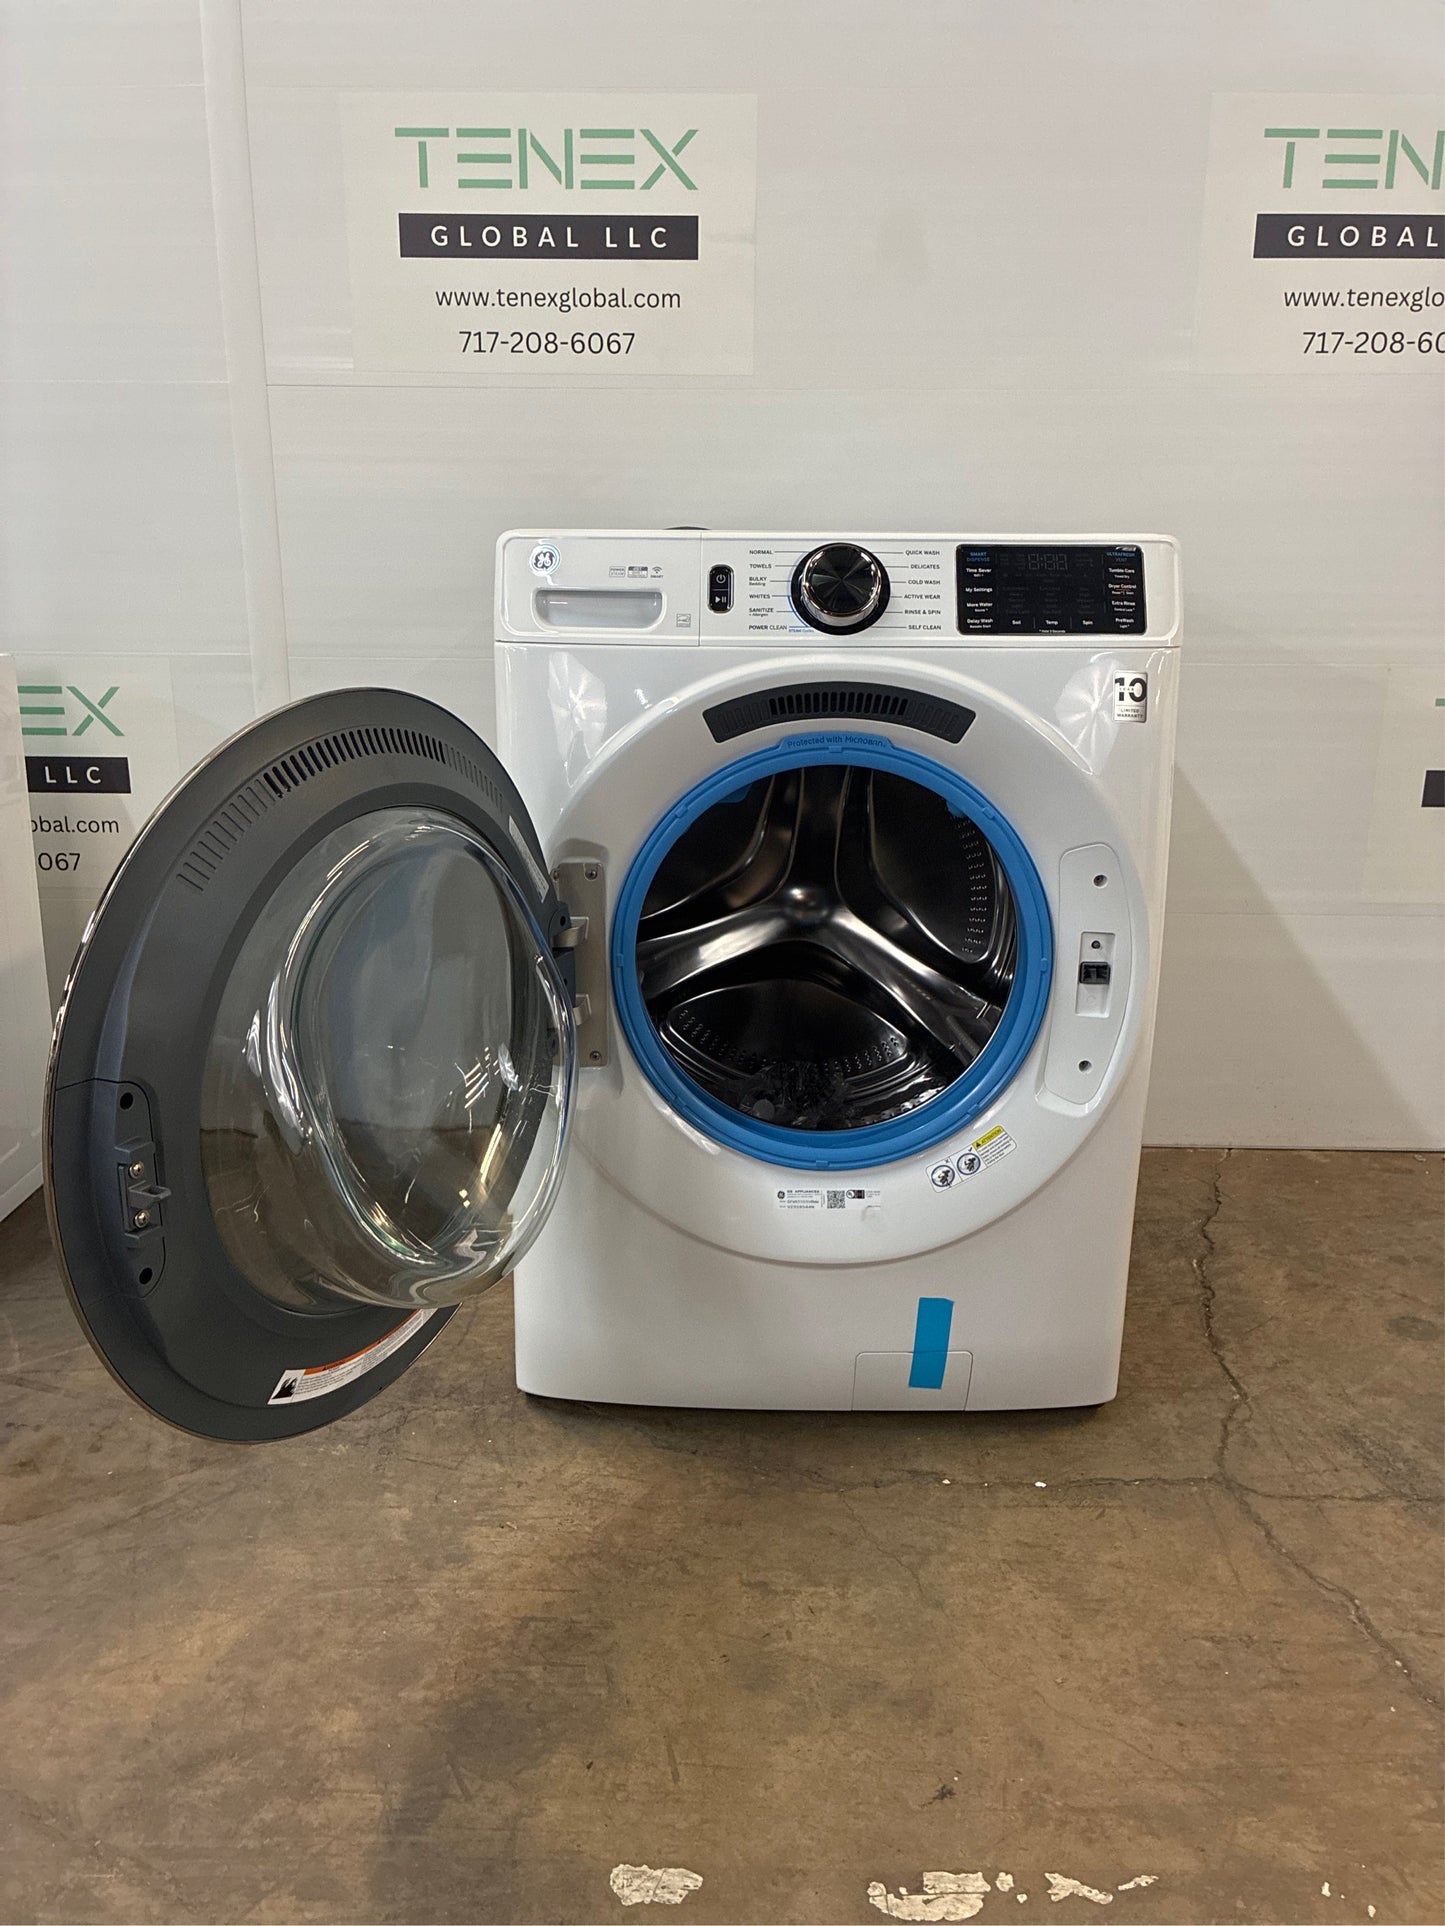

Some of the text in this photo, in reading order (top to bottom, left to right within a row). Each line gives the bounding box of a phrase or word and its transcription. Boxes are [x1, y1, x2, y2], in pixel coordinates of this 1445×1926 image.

[394, 127, 699, 190] TENEX
[430, 225, 669, 249] GLOBAL LLC
[1287, 225, 1439, 248] GLOBAL
[434, 287, 682, 314] www.tenexglobal.com
[458, 331, 636, 355] 717-208-6067
[1114, 677, 1147, 703] 10
[787, 736, 825, 749] Protected
[825, 735, 843, 744] with
[44, 766, 102, 784] LLC
[38, 852, 81, 871] 067
